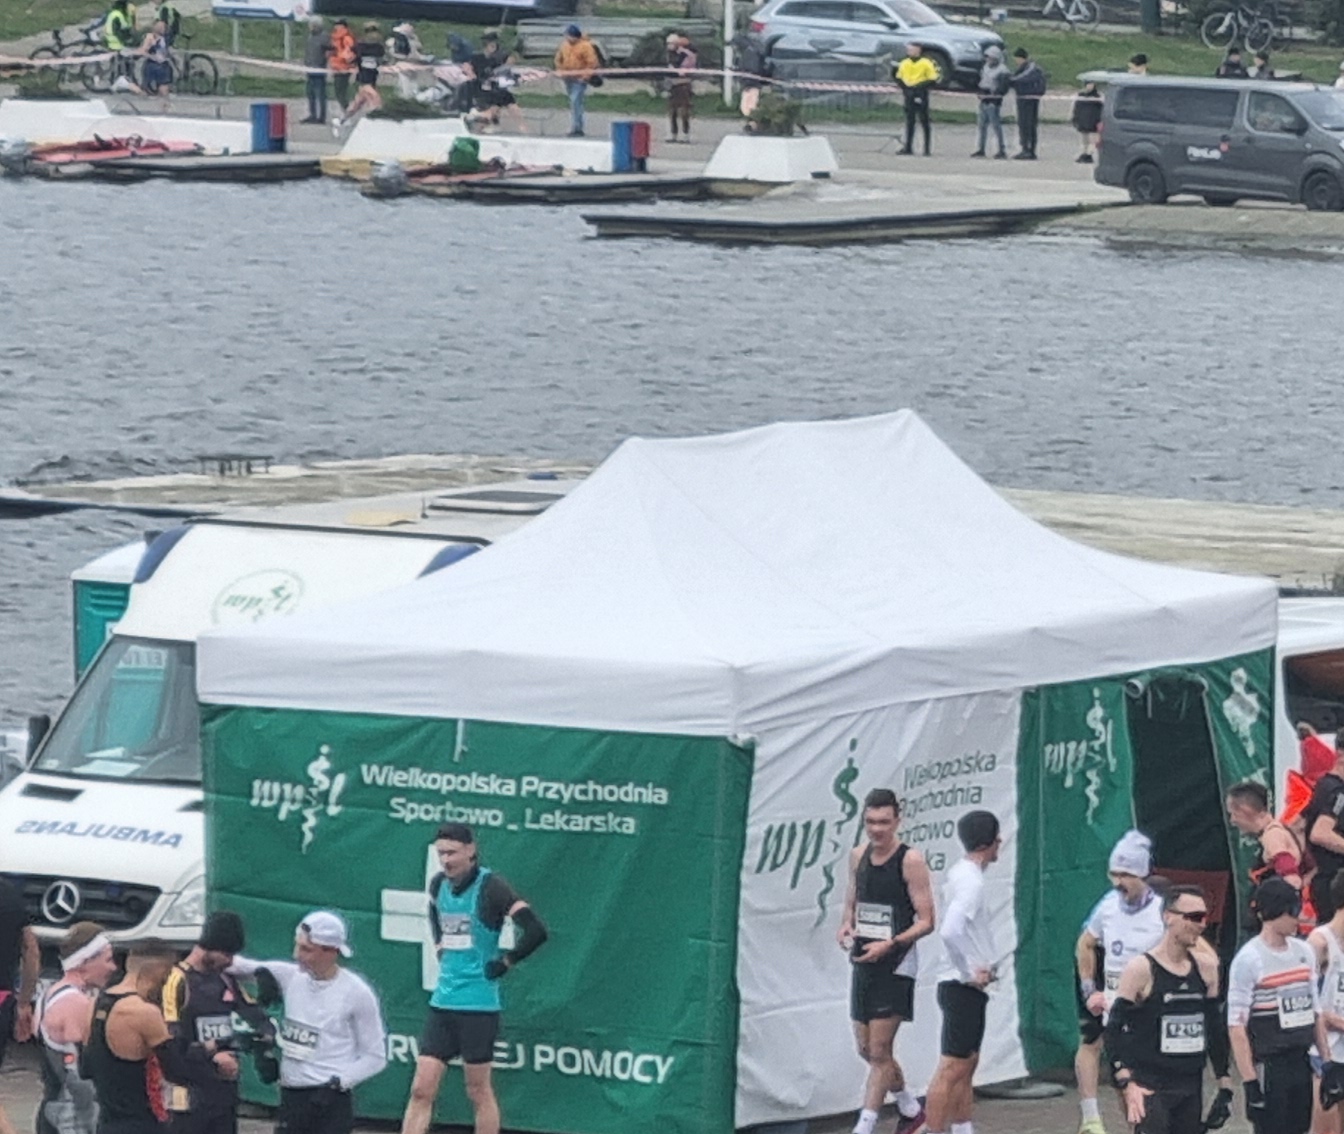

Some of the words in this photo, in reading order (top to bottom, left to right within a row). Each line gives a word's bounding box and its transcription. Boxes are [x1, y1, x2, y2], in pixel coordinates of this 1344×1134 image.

[360, 763, 516, 797] Wielkopolska
[520, 776, 669, 806] Przychodnia
[388, 797, 503, 829] Sportowo
[524, 808, 636, 835] Lekarska
[533, 1044, 675, 1084] POMOCY
